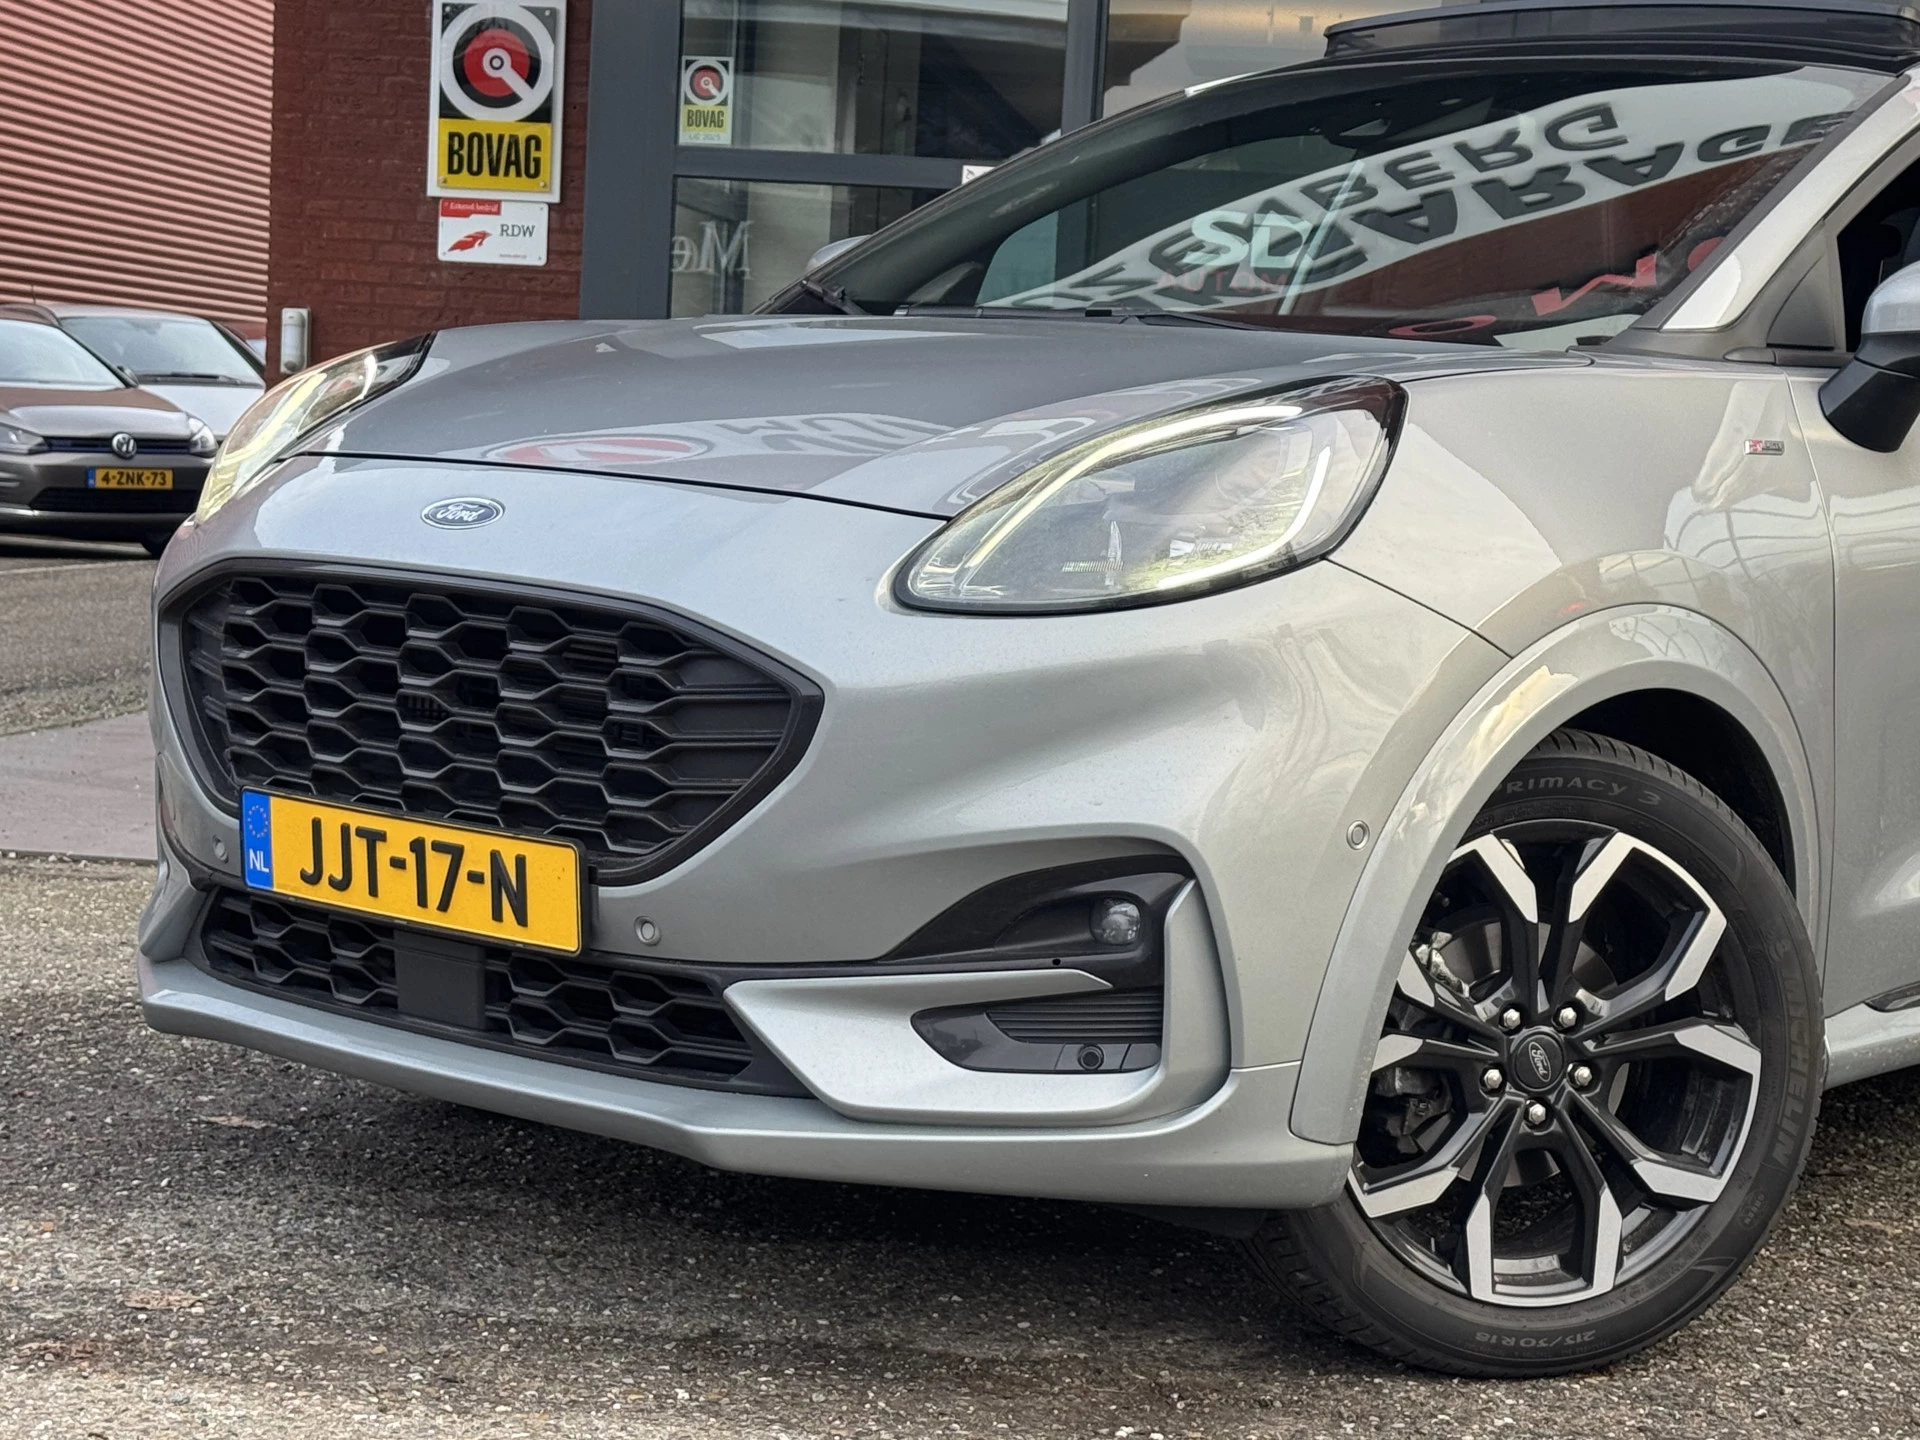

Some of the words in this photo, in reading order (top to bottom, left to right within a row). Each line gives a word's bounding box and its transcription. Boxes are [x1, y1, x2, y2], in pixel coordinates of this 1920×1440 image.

[687, 109, 725, 128] BOVAG
[447, 131, 542, 179] BOVAG
[500, 224, 535, 238] RDW
[101, 470, 167, 486] 4-ZNK-73
[436, 502, 485, 521] Ford
[249, 848, 270, 874] NL
[300, 816, 528, 928] JJT-17-N
[1531, 1048, 1549, 1077] Ford
